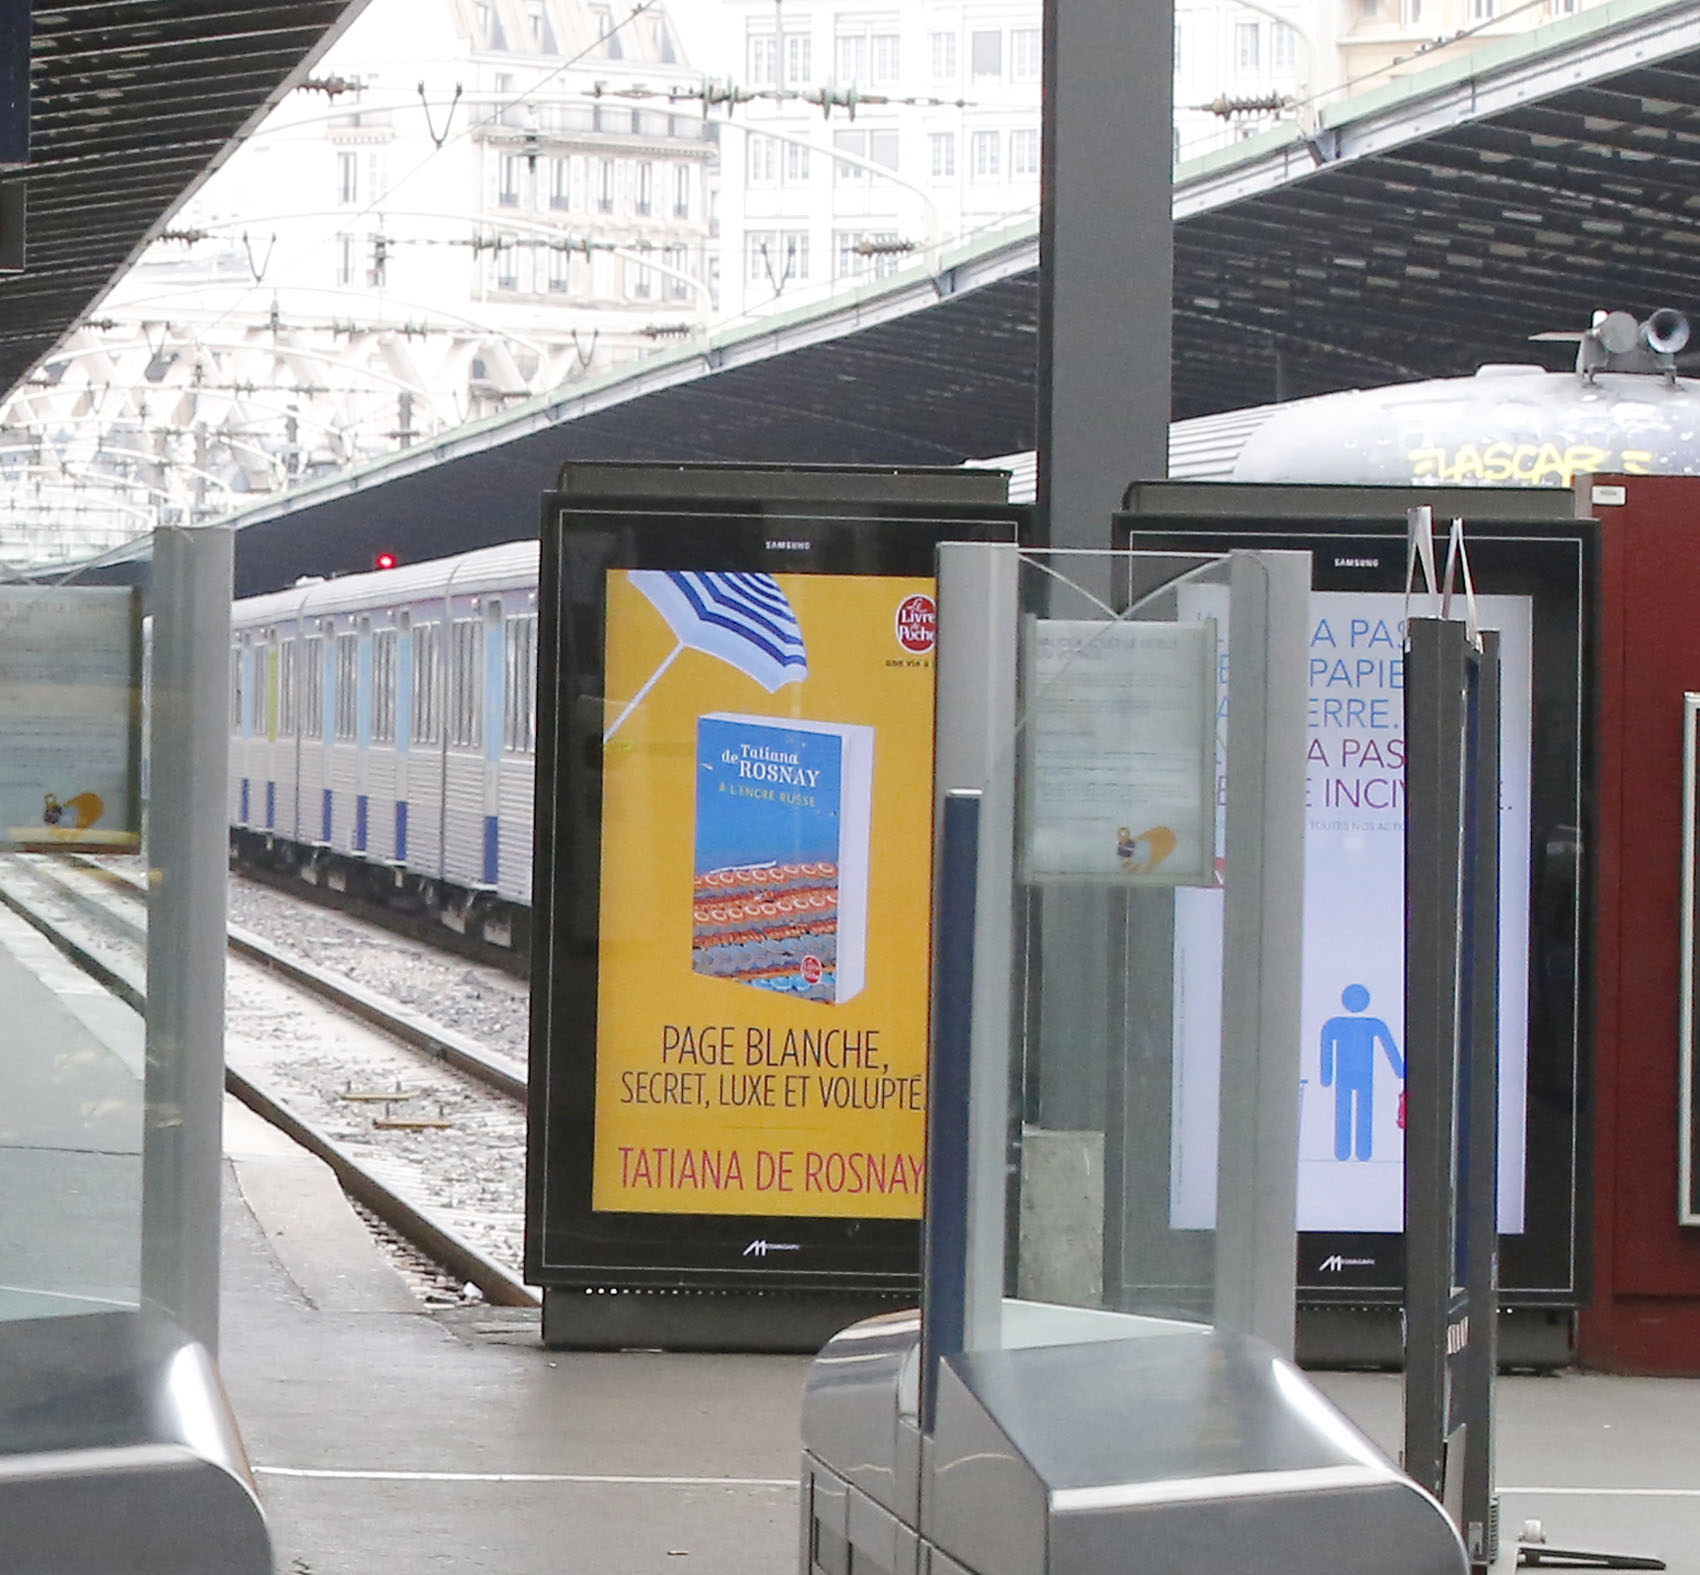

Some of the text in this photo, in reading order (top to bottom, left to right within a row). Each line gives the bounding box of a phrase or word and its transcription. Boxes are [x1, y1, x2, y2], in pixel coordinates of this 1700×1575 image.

[1310, 659, 1405, 689] PAPIE
[1308, 698, 1400, 729] ERRE.
[721, 748, 821, 788] de ROSNAY
[740, 743, 799, 764] Tatiana
[662, 1025, 889, 1074] PAGE BLANCHE,
[620, 1071, 710, 1109] SECRET,
[719, 1074, 777, 1107] LUXE
[784, 1075, 811, 1108] ET
[618, 1146, 927, 1195] TATIANA DE ROSNAY
